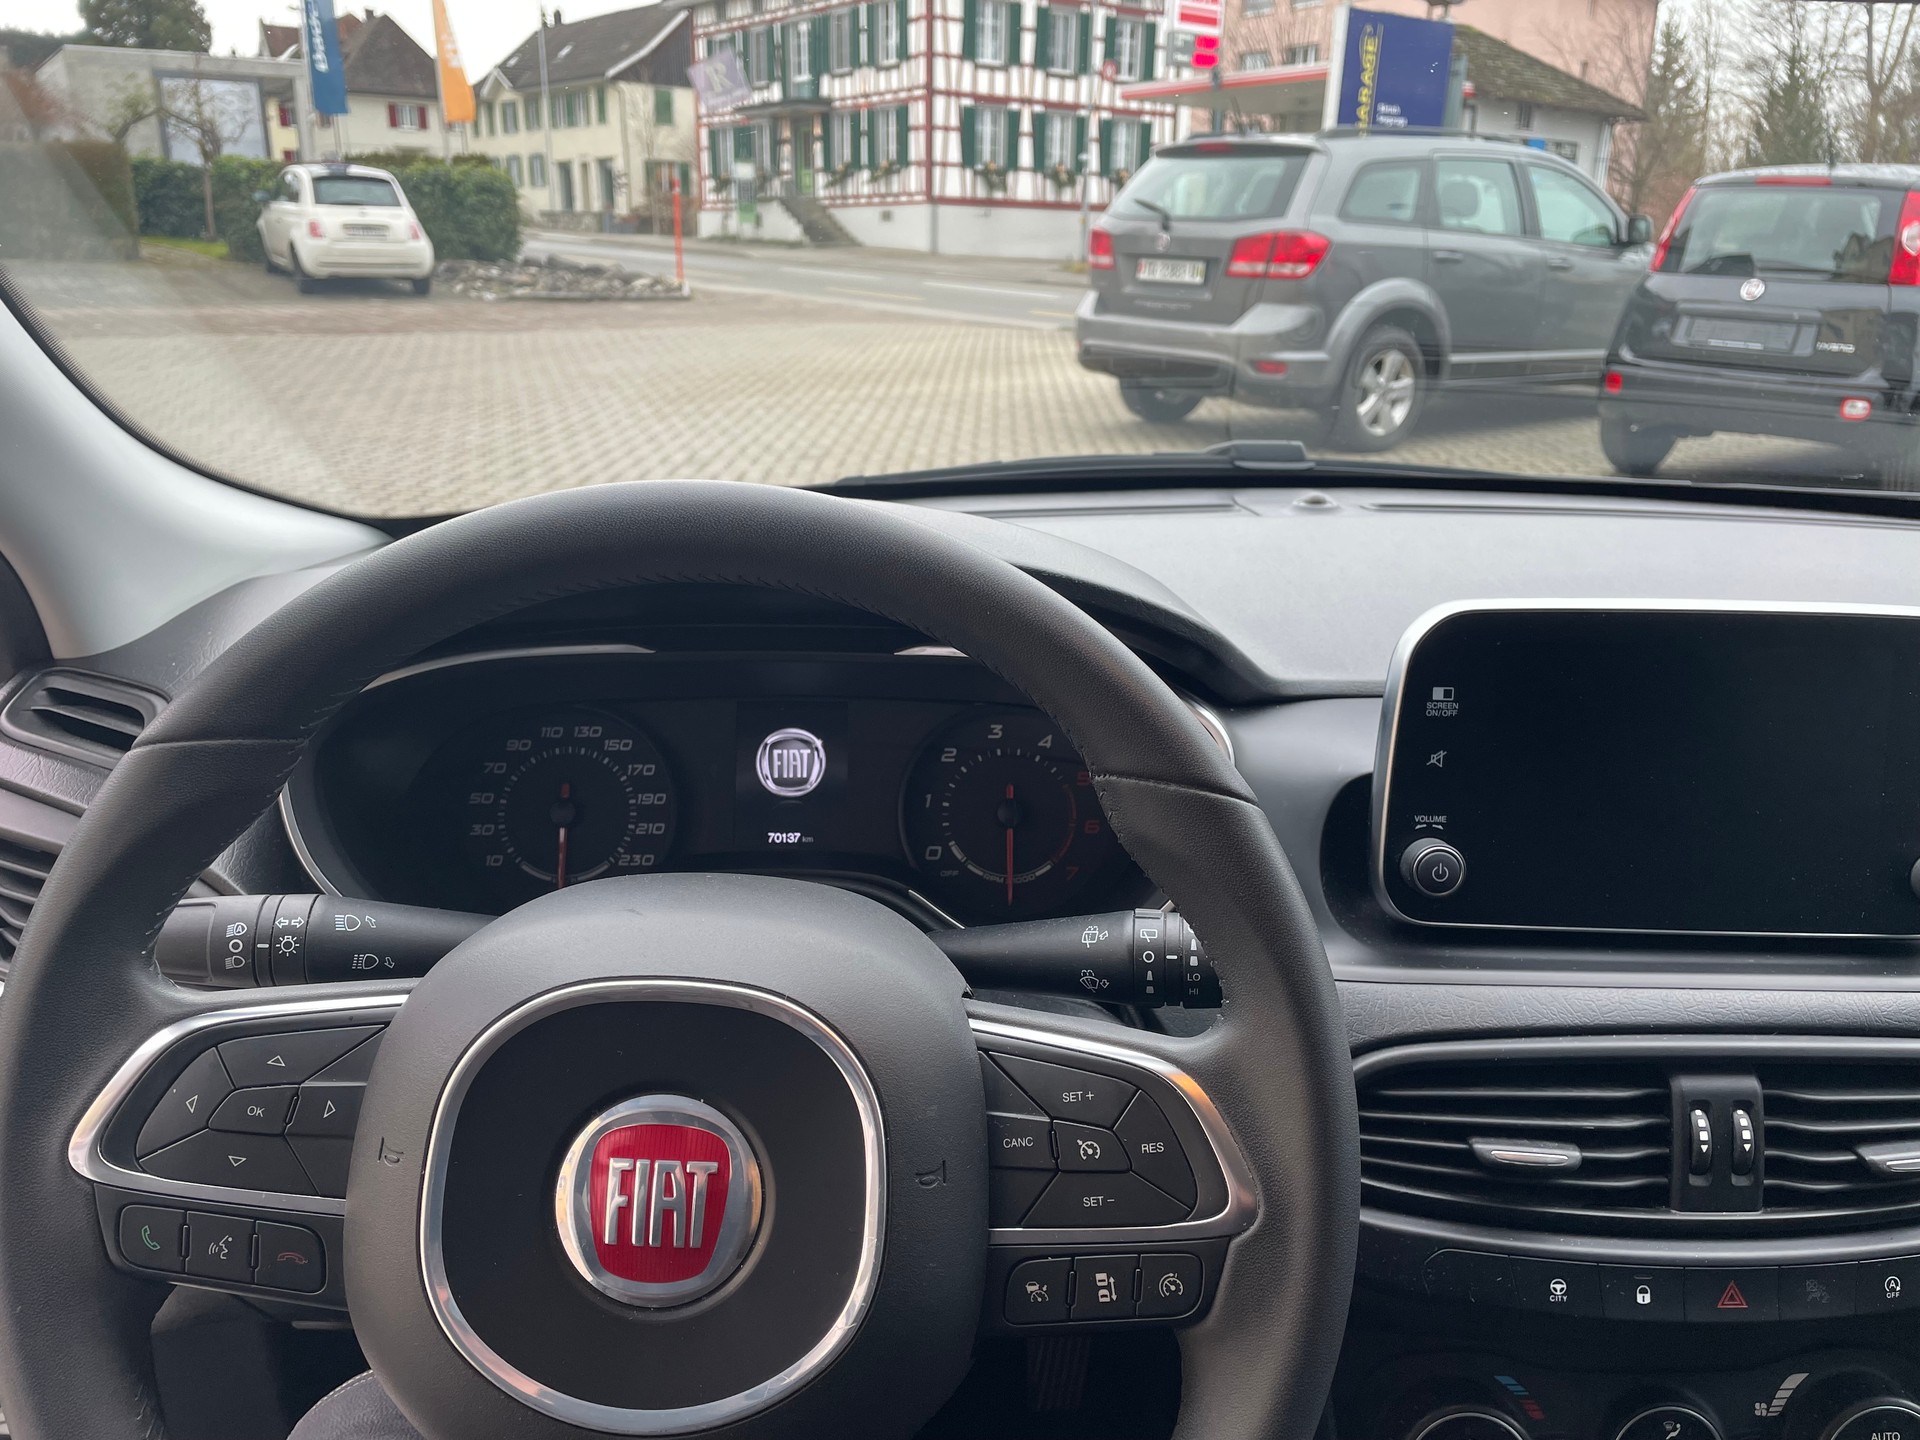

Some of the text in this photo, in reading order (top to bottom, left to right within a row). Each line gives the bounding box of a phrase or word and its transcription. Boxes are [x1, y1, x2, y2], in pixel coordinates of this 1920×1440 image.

[705, 62, 734, 94] R
[1426, 702, 1459, 710] SCREEN
[1426, 709, 1458, 717] ON/OFF
[540, 726, 564, 738] 110
[574, 726, 602, 738] 130
[987, 724, 1004, 739] 3
[506, 739, 532, 750] 90
[603, 739, 633, 751] 150
[1038, 735, 1053, 749] 4
[941, 748, 957, 762] 2
[483, 762, 507, 774] 70
[773, 749, 811, 778] FIAT
[627, 764, 655, 776] 170
[469, 793, 494, 805] 50
[636, 793, 666, 805] 190
[925, 795, 932, 808] 1
[1414, 815, 1447, 823] VOLUME
[470, 824, 495, 836] 30
[635, 823, 665, 835] 210
[1084, 820, 1100, 834] 6
[767, 832, 801, 843] 70137
[925, 846, 942, 860] 0
[485, 855, 504, 867] 10
[618, 854, 654, 866] 230
[1065, 866, 1079, 881] 7
[1187, 973, 1201, 981] LO
[1188, 987, 1199, 995] HI
[1062, 1091, 1083, 1103] SET
[247, 1105, 265, 1117] OK
[1003, 1137, 1034, 1148] CANC
[1141, 1142, 1164, 1154] RES
[604, 1157, 719, 1248] FIAT
[1083, 1196, 1104, 1207] SET
[1871, 1431, 1901, 1440] AUTO
